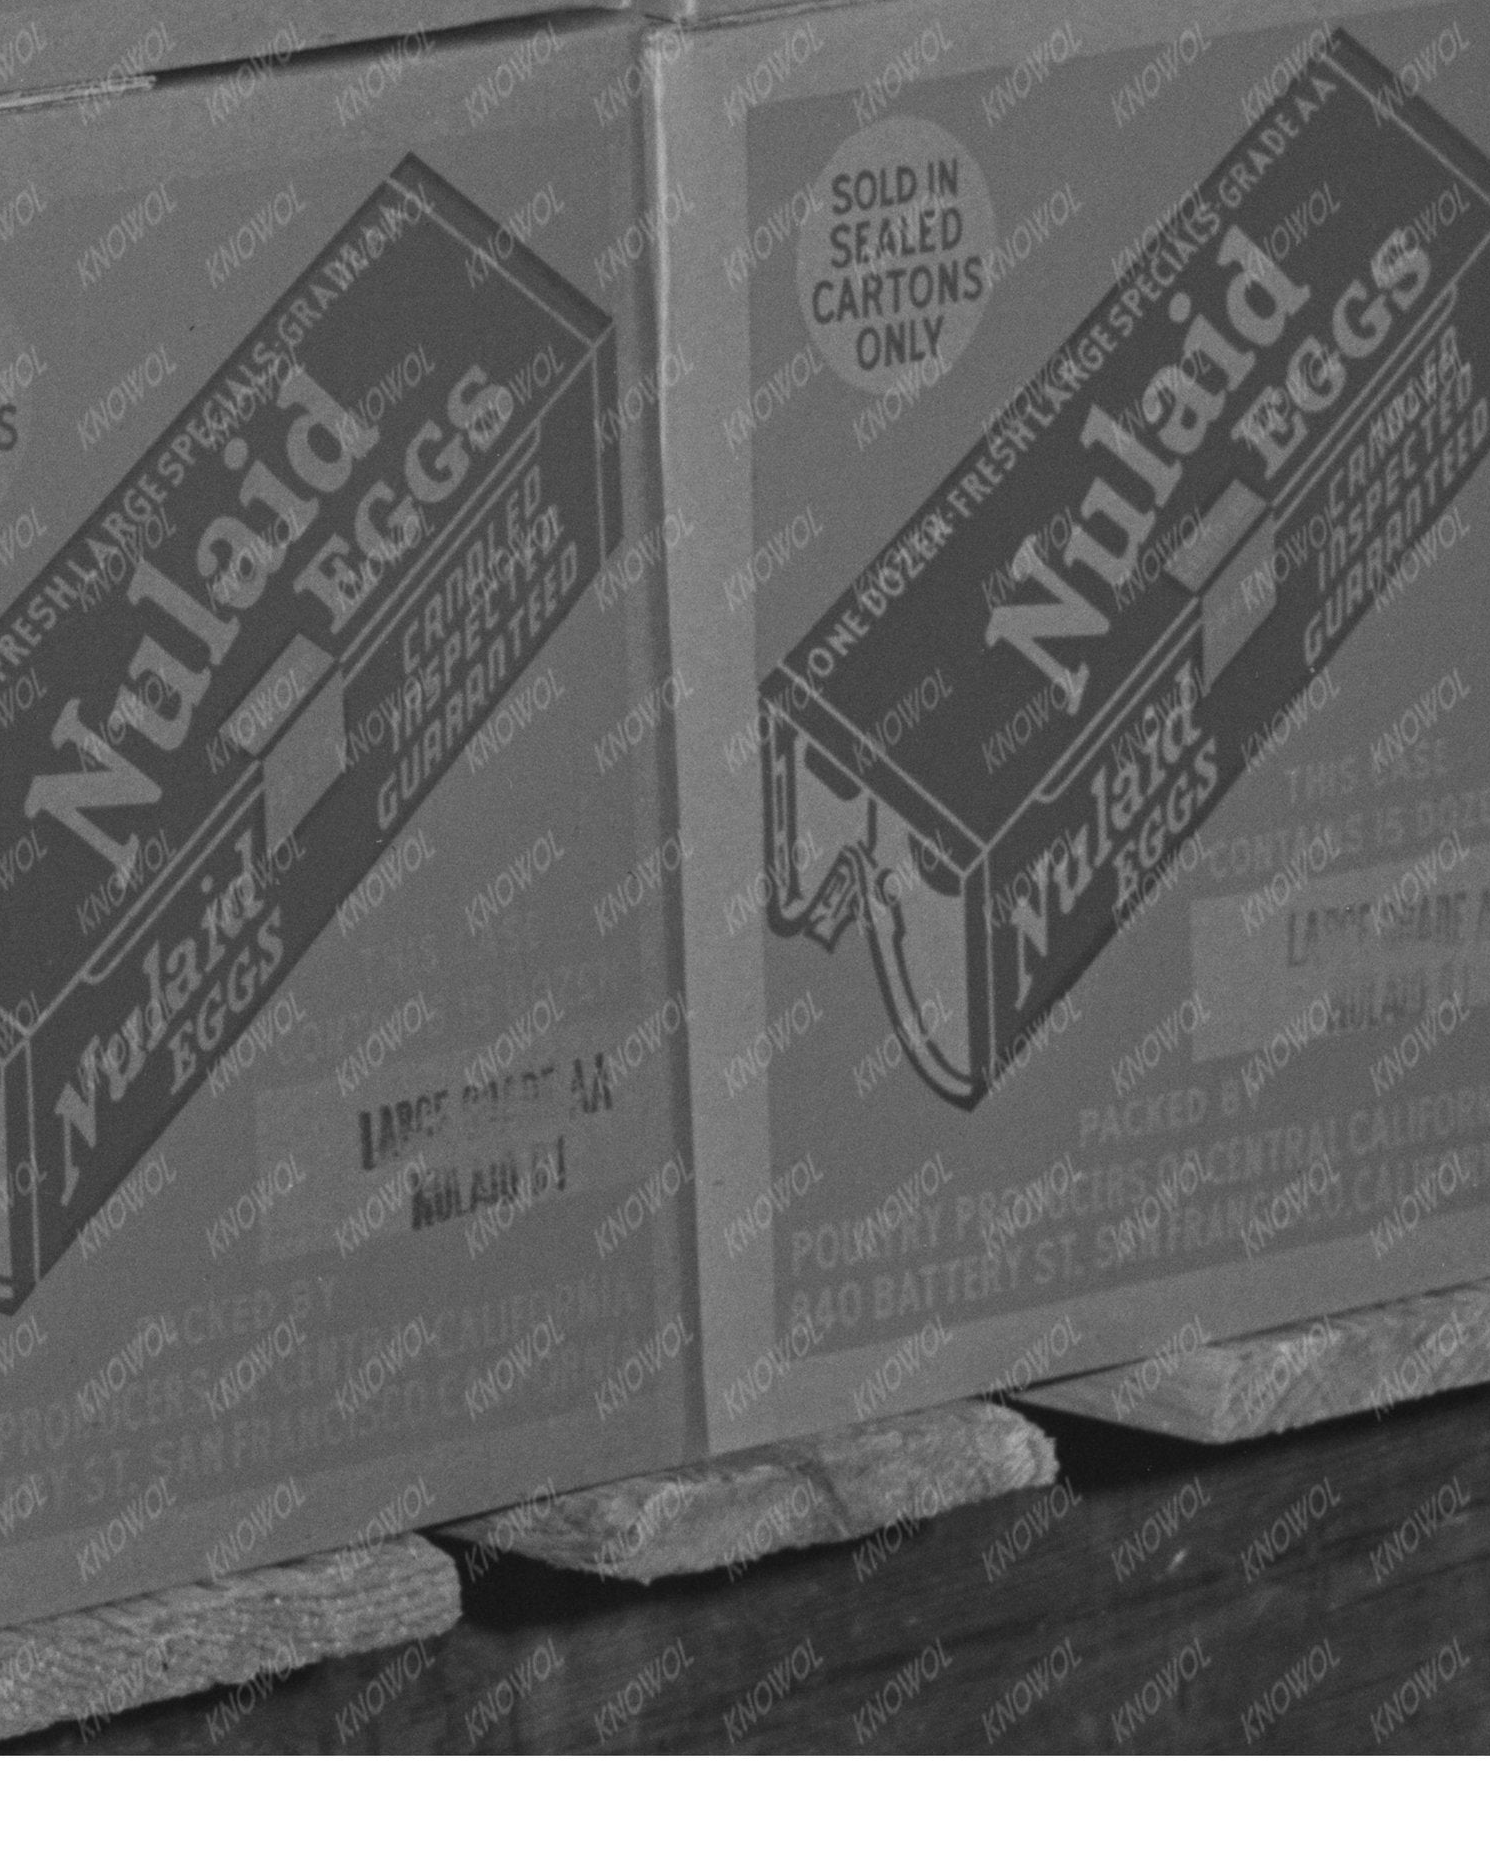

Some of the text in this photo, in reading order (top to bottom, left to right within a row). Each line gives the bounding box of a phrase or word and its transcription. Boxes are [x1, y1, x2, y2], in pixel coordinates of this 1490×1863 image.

[812, 256, 984, 326] CARTONS
[829, 206, 963, 271] SEALED
[831, 159, 959, 217] SOLD IN
[856, 315, 944, 372] ONLY
[1232, 229, 1431, 477] EGGS
[293, 367, 511, 635] EGGS
[986, 225, 1310, 715] Nulaid
[24, 367, 380, 889] Nulaid
[1012, 662, 1203, 1010] Nulaid
[1114, 740, 1220, 910] EGGS
[56, 826, 264, 1207] Nulaid
[168, 910, 285, 1099] EGGS
